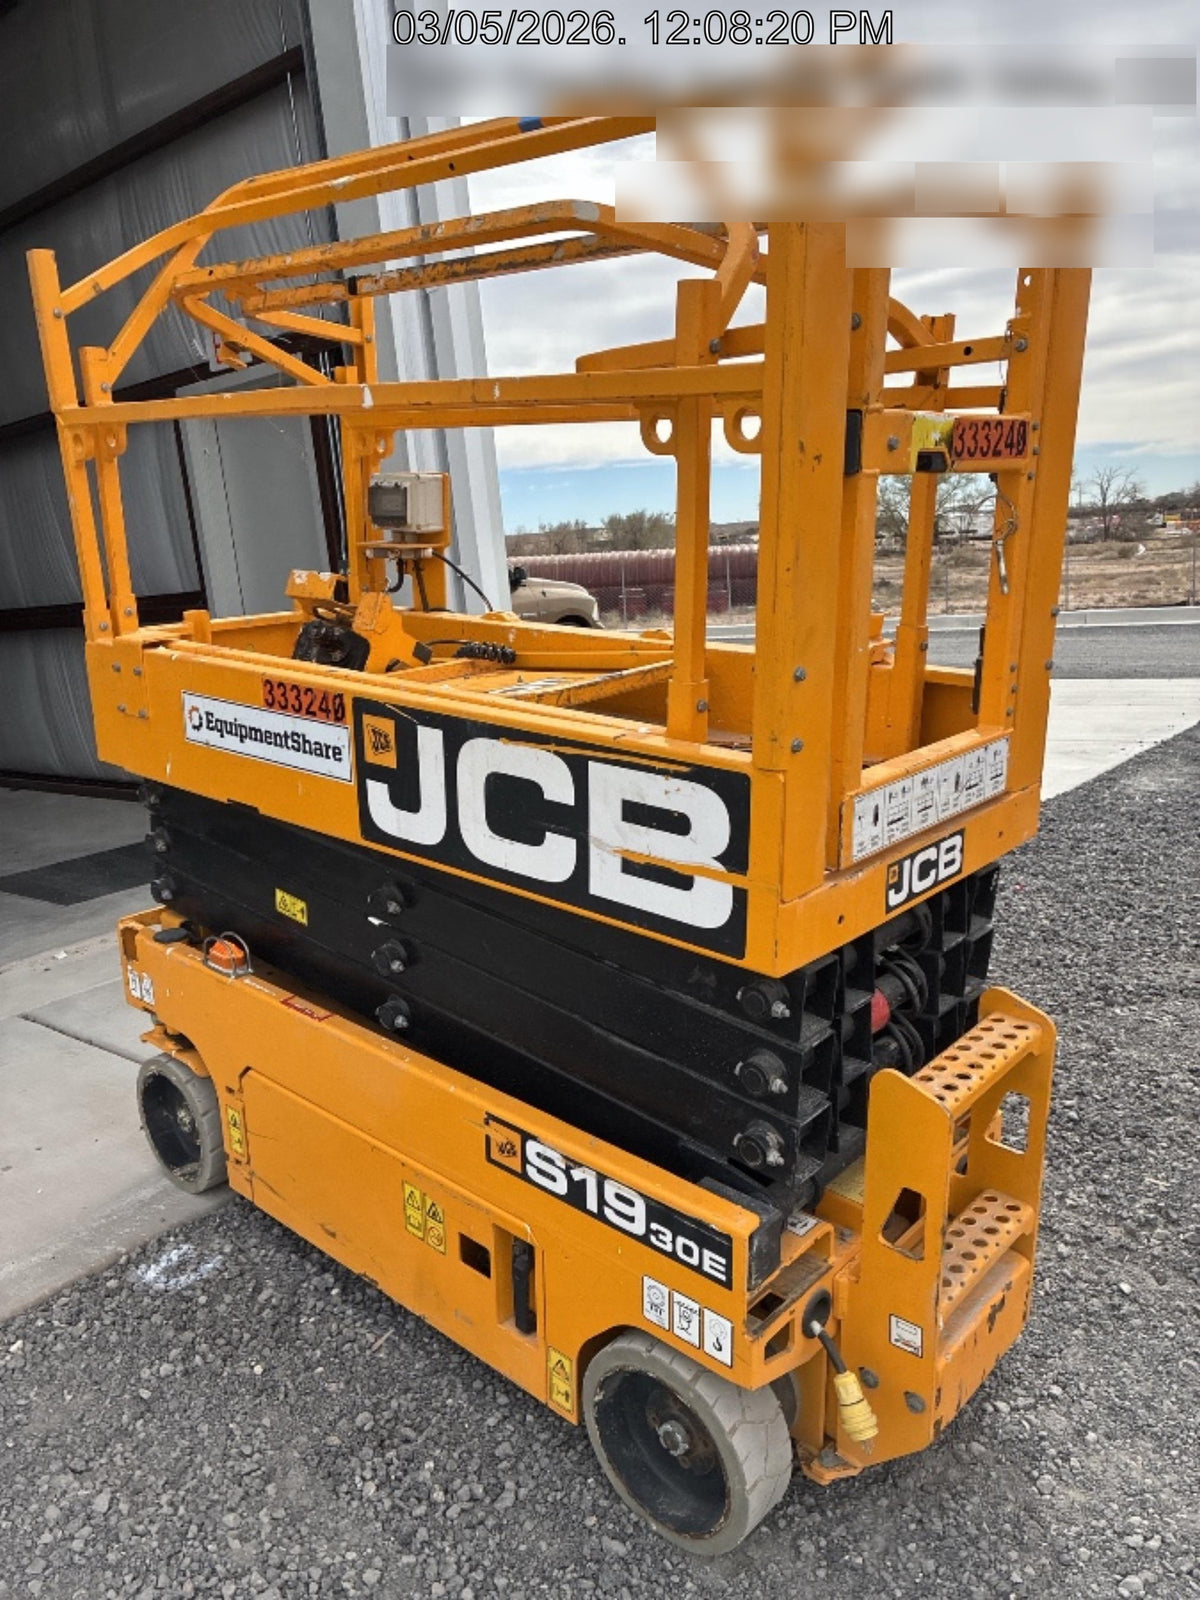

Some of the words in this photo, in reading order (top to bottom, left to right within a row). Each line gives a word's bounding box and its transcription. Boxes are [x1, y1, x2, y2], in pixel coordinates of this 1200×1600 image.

[204, 710, 343, 762] EquipmentShare
[366, 724, 733, 929] JCB
[888, 834, 963, 907] JCB
